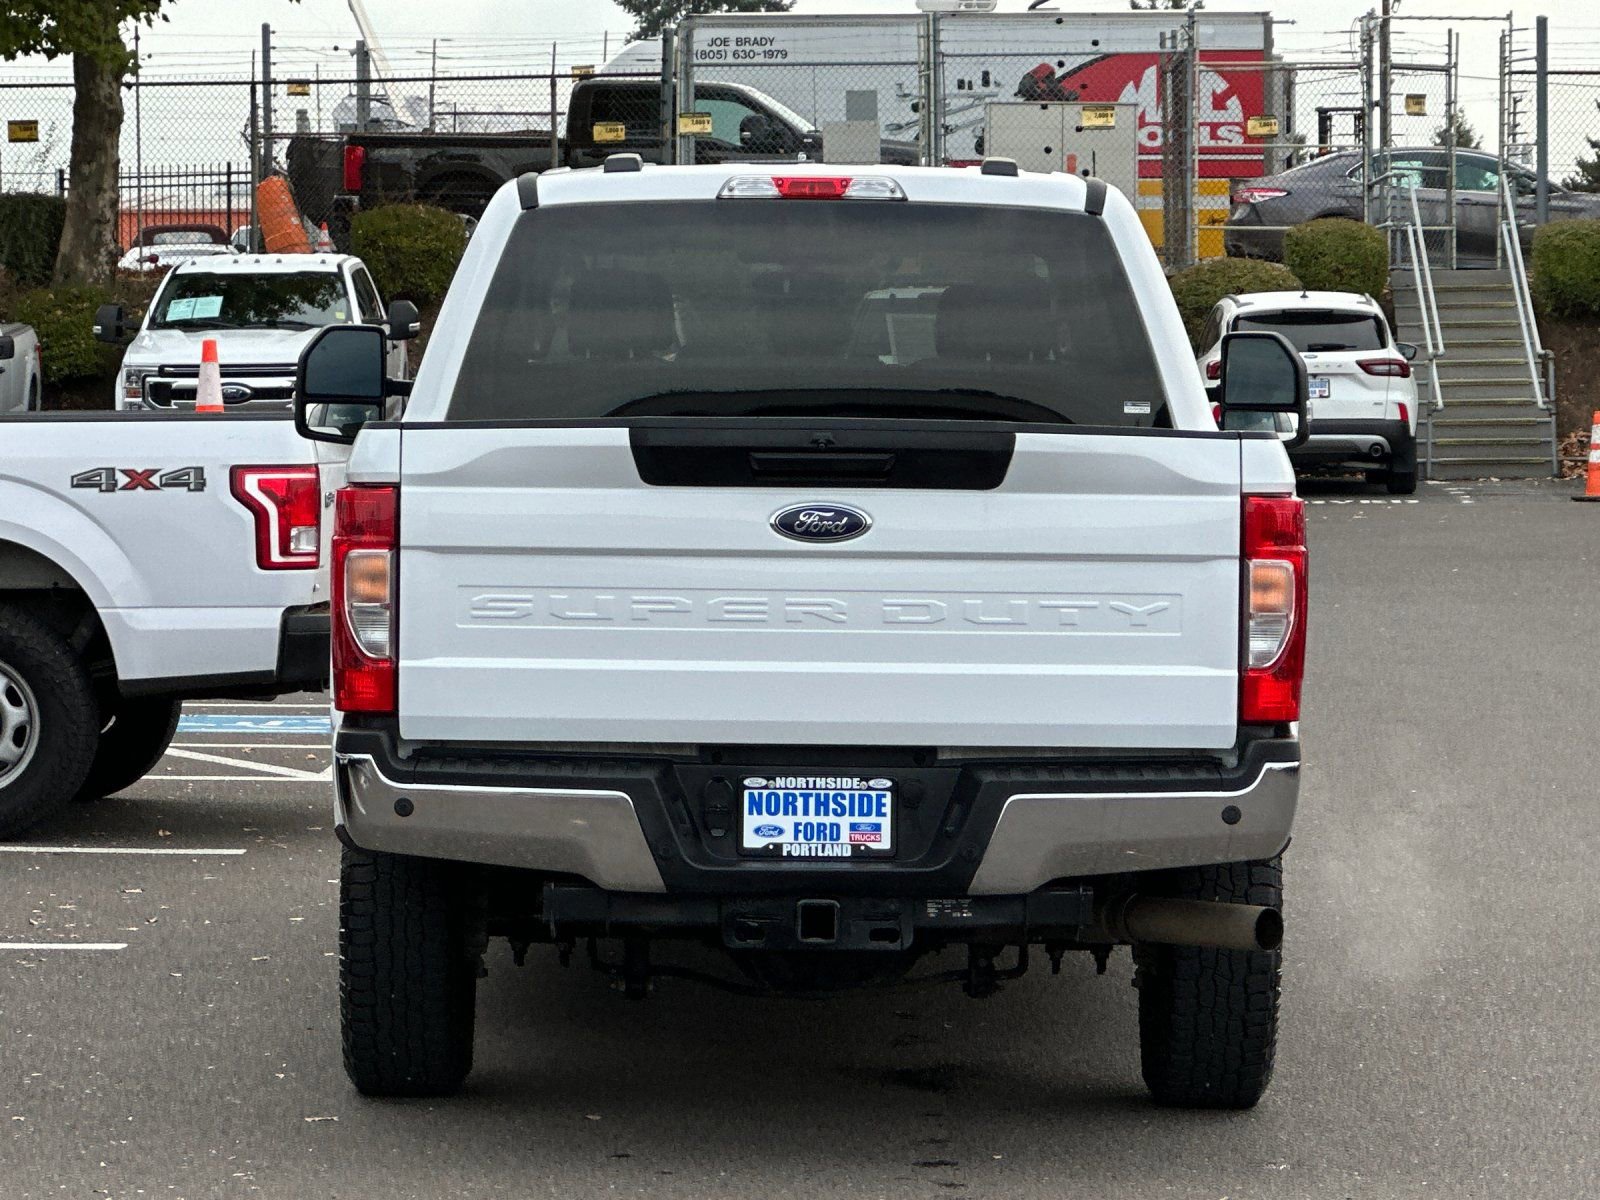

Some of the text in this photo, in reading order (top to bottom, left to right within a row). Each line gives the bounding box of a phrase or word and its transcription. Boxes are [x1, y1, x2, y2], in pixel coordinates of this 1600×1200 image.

[707, 37, 775, 47] JOE BRADY
[695, 48, 788, 60] (805) 630-1979
[1117, 64, 1245, 123] MC
[794, 510, 848, 533] Ford
[470, 593, 1170, 627] SUPER DUTY
[775, 777, 861, 789] NORTHSIDE
[748, 791, 888, 817] NORTHSIDE
[757, 825, 780, 837] Ford
[793, 822, 841, 842] FORD
[851, 834, 881, 842] TRUCKS
[782, 844, 852, 857] PORTLAND
